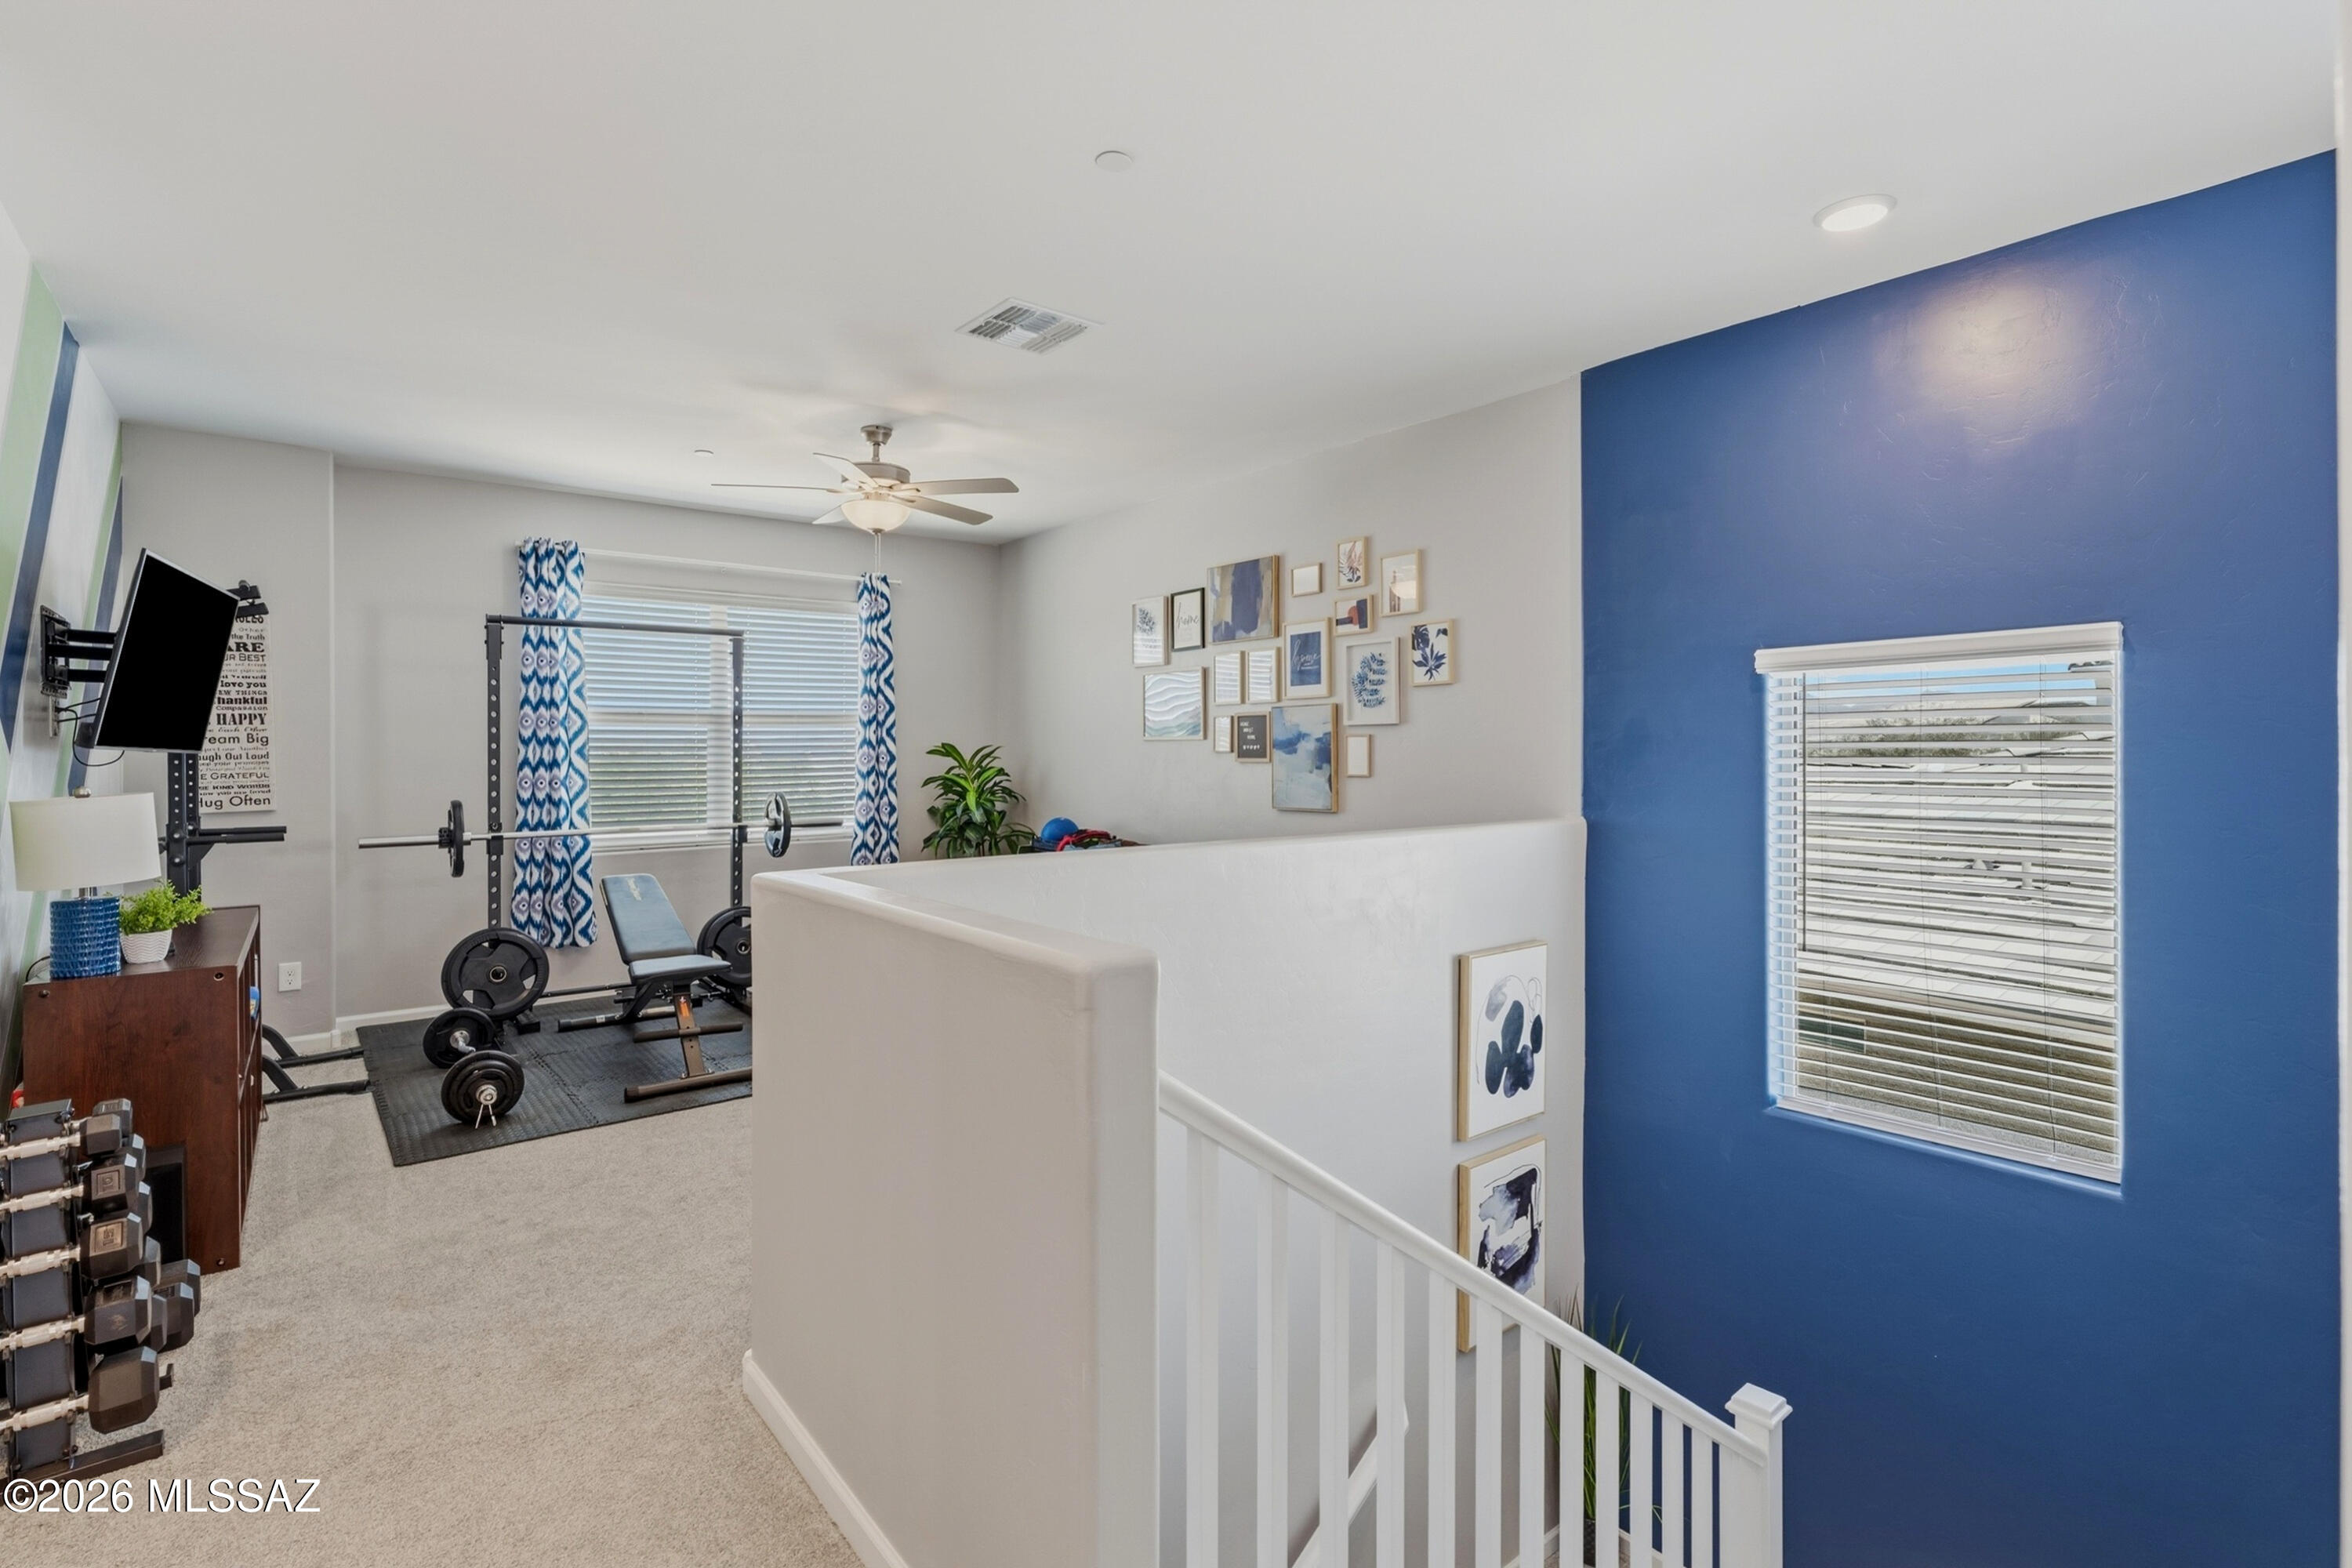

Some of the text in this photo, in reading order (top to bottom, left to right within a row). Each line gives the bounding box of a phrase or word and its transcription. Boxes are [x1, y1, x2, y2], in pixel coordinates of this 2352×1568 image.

[238, 653, 266, 662] BEST
[215, 696, 267, 705] hankful
[216, 713, 267, 725] HAPPY
[247, 733, 269, 746] Big
[229, 794, 270, 807] Often
